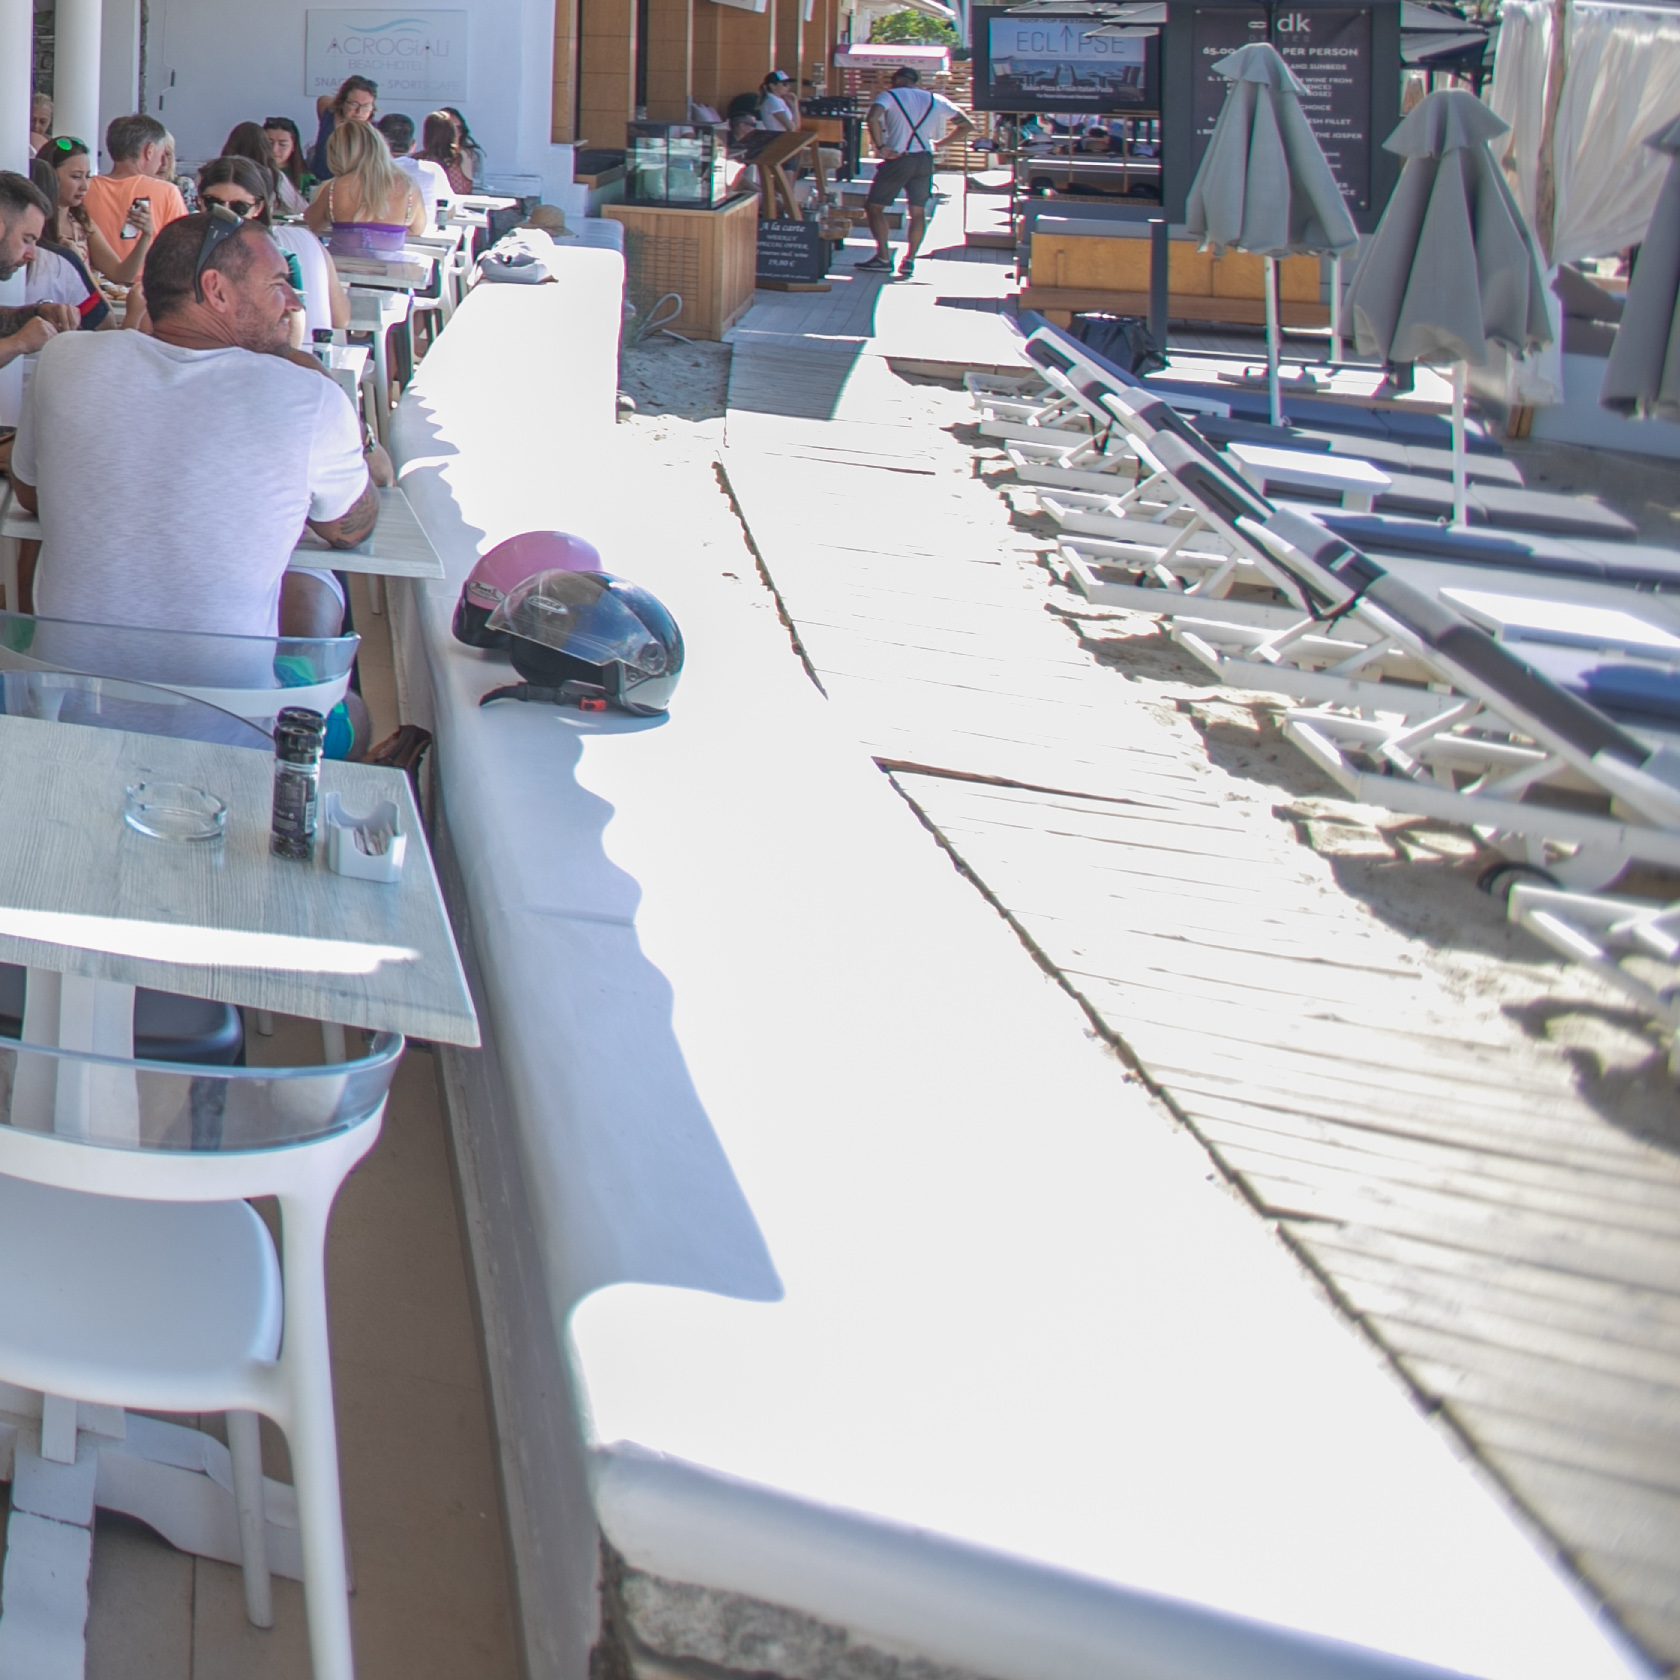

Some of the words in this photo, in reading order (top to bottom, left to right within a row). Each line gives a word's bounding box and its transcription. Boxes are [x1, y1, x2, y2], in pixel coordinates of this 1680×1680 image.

[1276, 13, 1311, 32] dk
[1282, 47, 1306, 56] PER
[1308, 47, 1359, 56] PERSON
